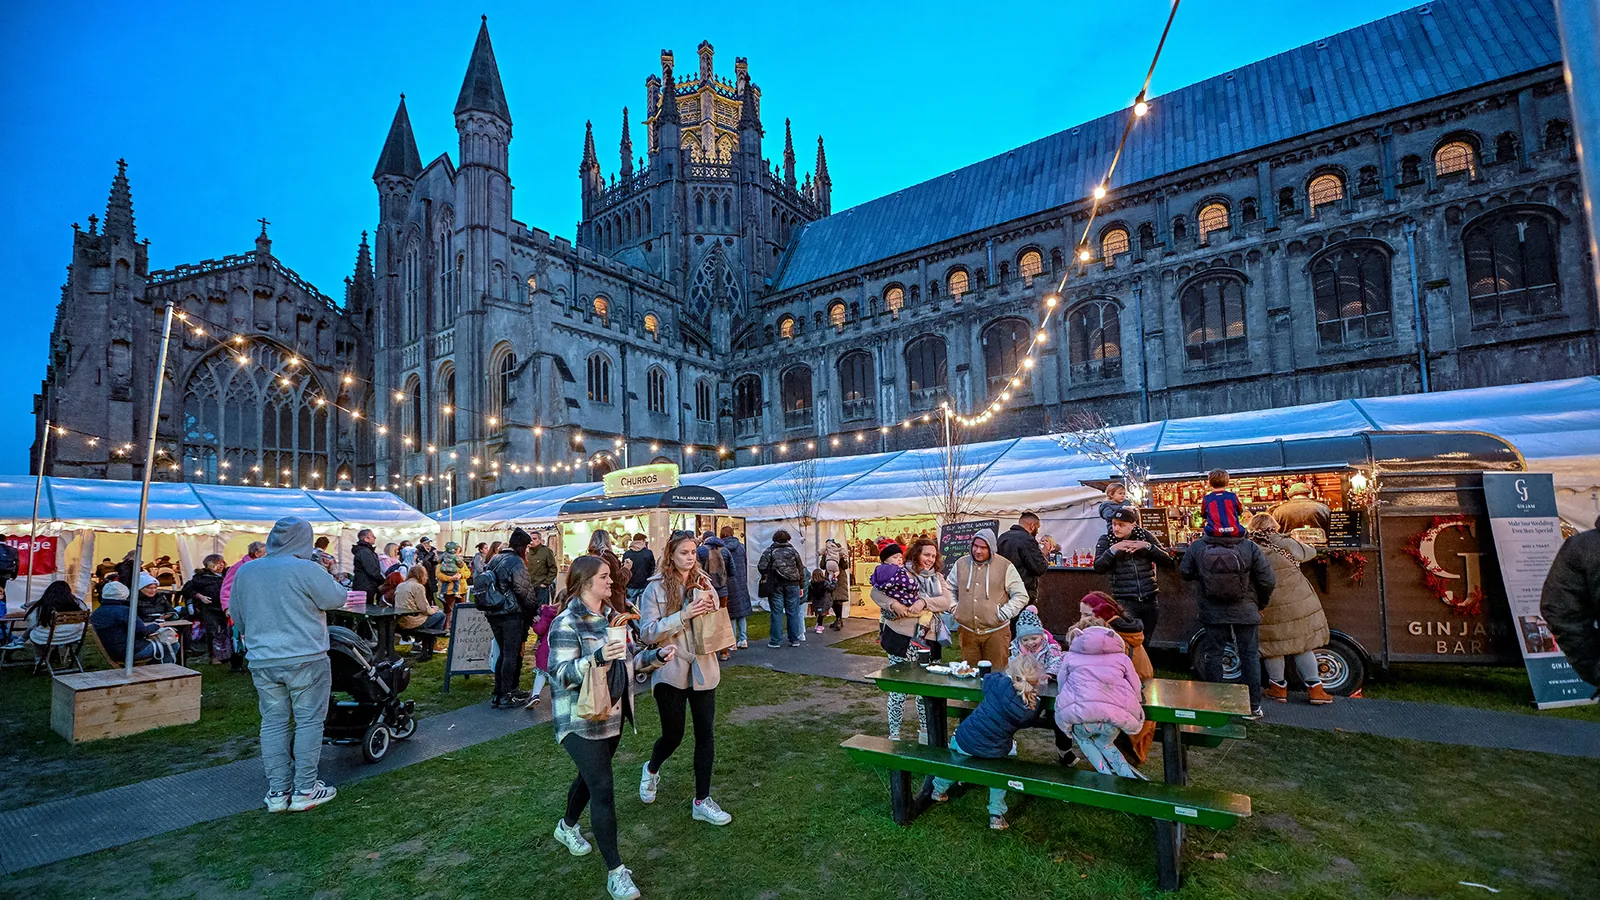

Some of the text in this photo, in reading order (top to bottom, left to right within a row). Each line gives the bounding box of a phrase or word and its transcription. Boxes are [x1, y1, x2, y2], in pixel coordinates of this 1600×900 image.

[621, 475, 658, 486] CHURROS
[6, 539, 51, 552] llage
[1408, 620, 1451, 635] GIN
[456, 636, 492, 644] INDULGE
[1436, 640, 1482, 654] BAR
